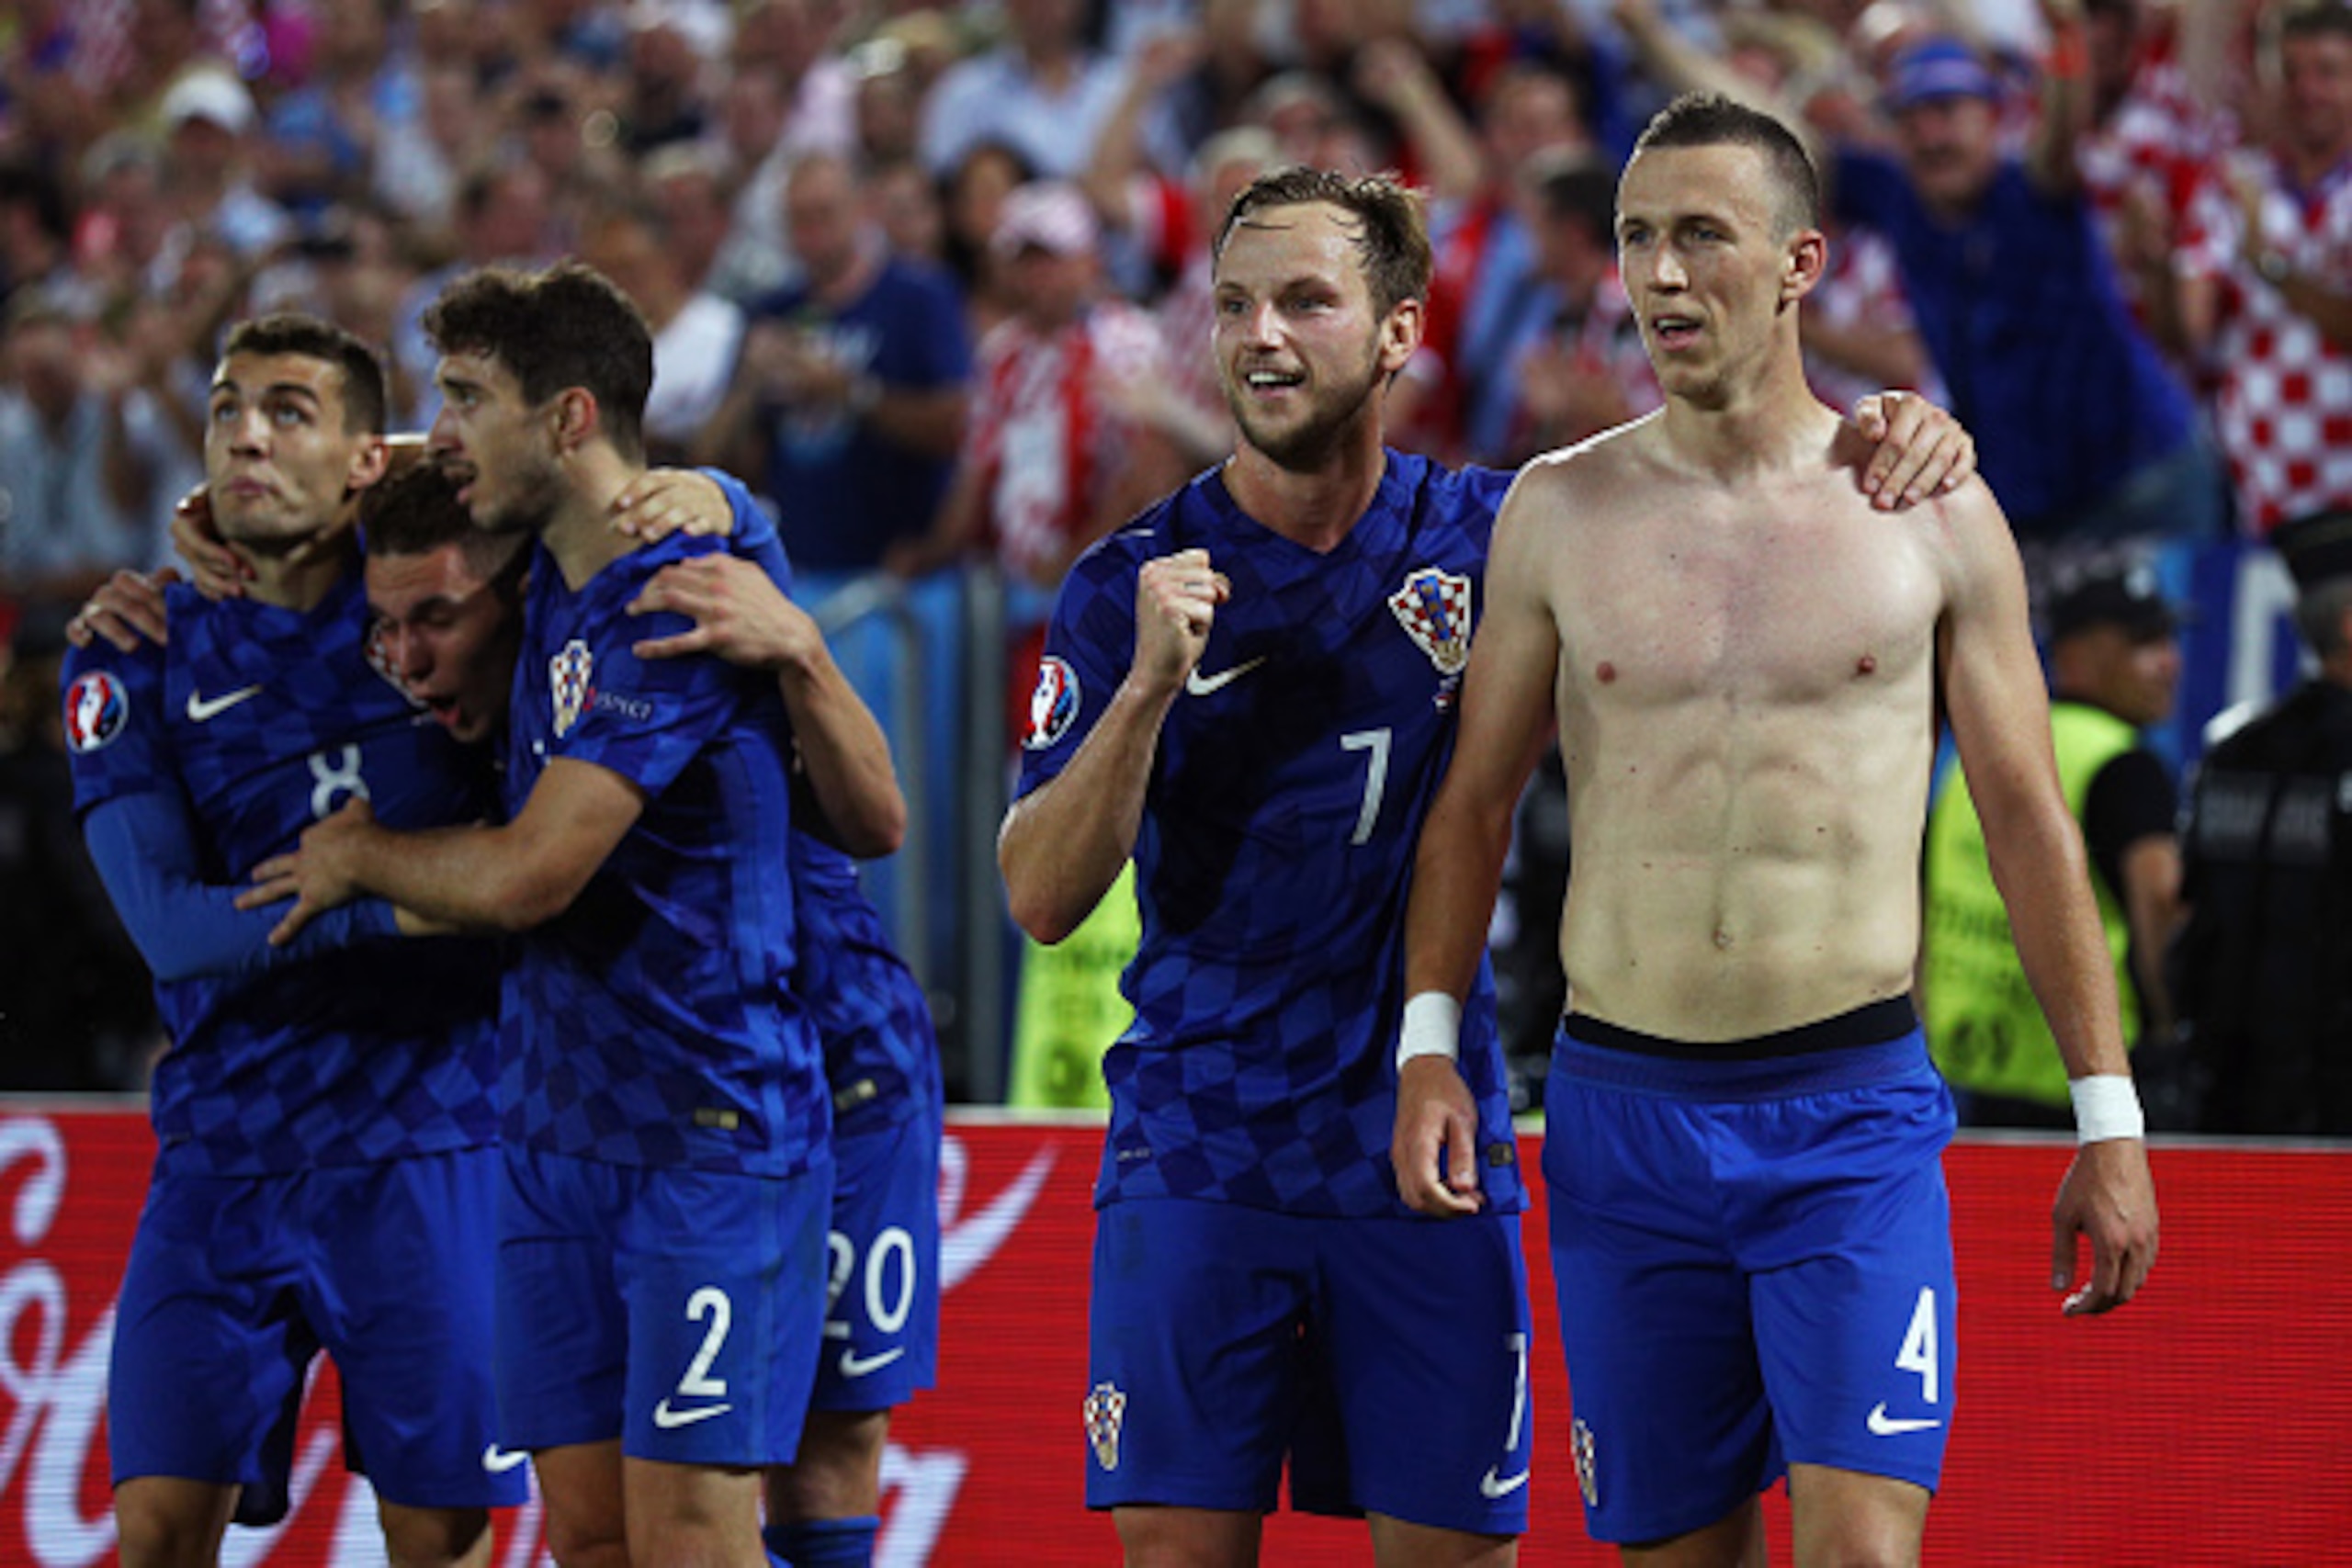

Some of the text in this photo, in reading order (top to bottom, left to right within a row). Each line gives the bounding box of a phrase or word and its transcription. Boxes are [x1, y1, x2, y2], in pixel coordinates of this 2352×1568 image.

[307, 741, 371, 821] 8
[1339, 726, 1393, 846] 7
[826, 1226, 915, 1337] 20
[678, 1285, 731, 1396] 2
[1894, 1286, 1939, 1404] 4
